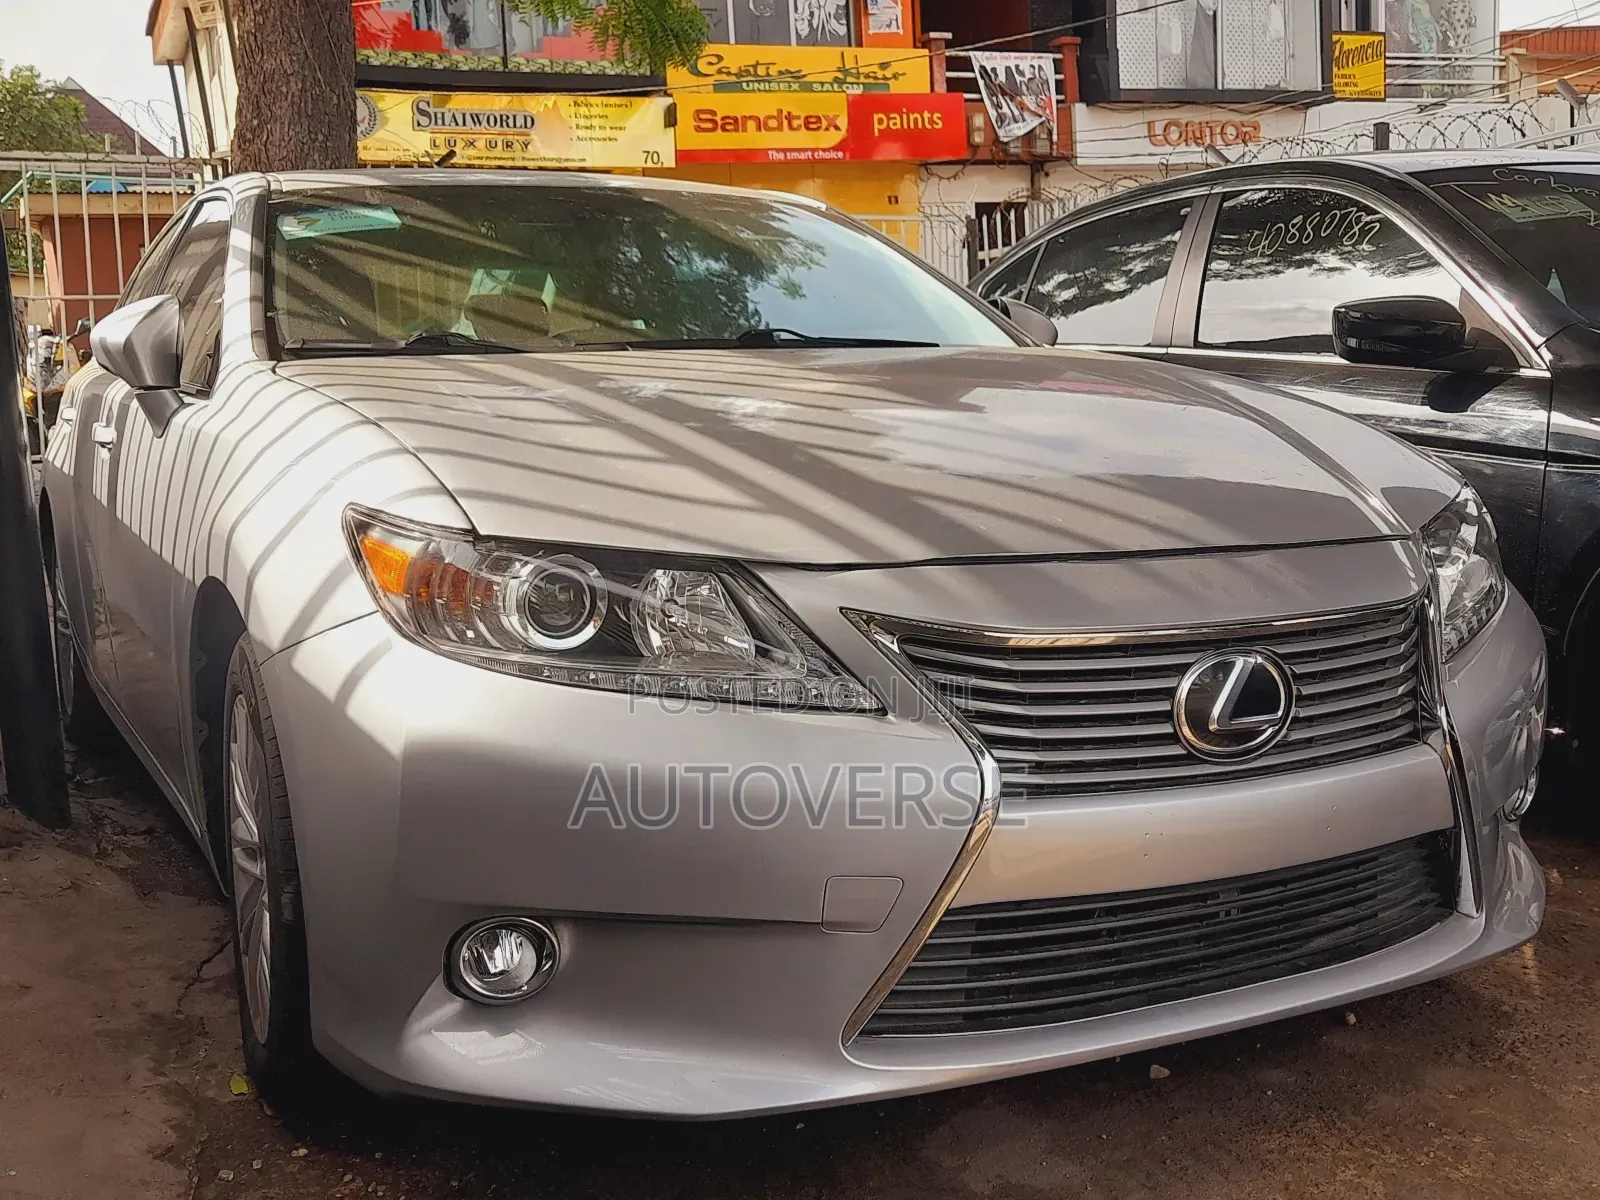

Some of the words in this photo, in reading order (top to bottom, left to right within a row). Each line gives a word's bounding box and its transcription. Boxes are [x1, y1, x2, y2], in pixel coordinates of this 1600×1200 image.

[742, 82, 800, 91] UNISEX
[812, 82, 864, 92] SALON
[415, 98, 535, 130] SHAIWORLD
[692, 108, 843, 134] Sandtex
[873, 108, 944, 136] paints
[431, 136, 533, 151] LUXURY
[642, 150, 664, 167] 70,
[767, 149, 785, 160] The
[786, 149, 813, 160] smart
[814, 149, 844, 160] choice
